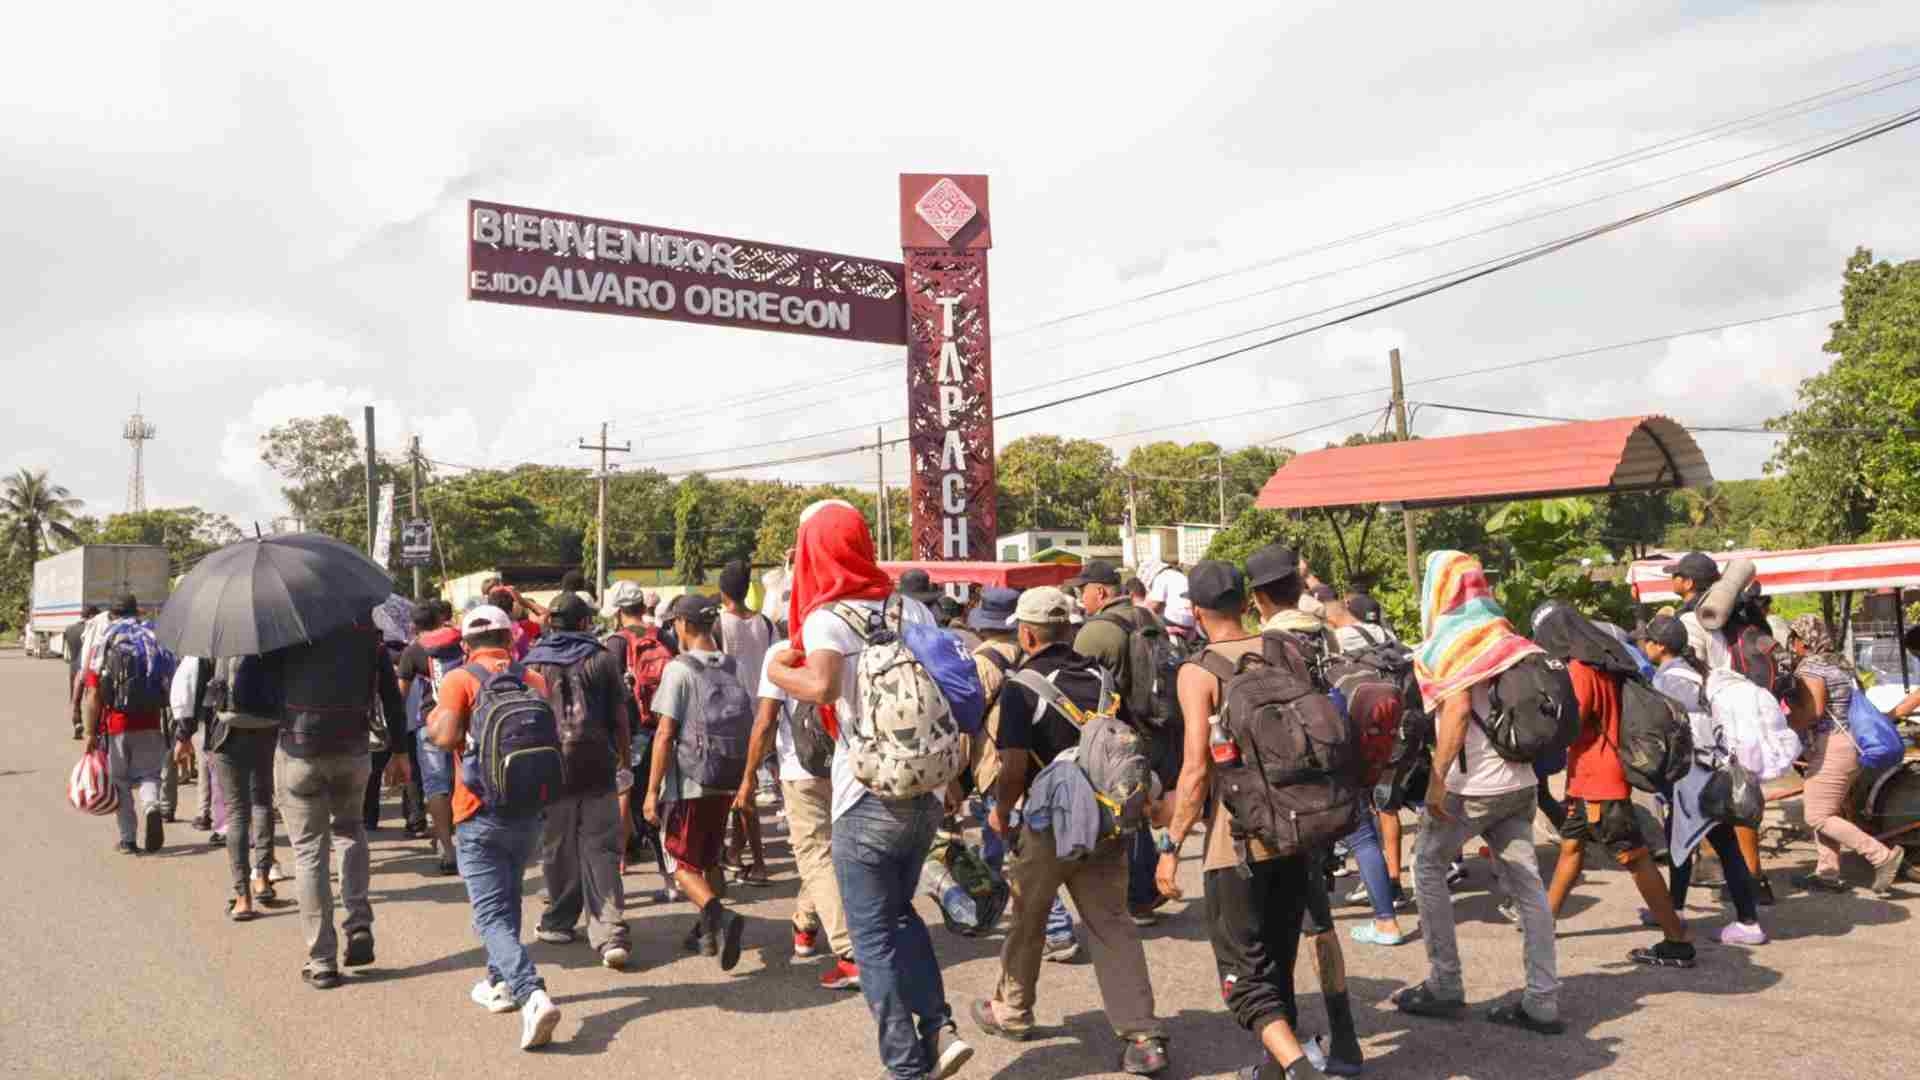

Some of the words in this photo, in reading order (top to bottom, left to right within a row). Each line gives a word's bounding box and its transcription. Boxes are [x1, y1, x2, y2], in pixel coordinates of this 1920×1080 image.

[473, 208, 737, 275] BIENVENIDOS
[471, 270, 538, 295] EJIDO
[537, 265, 676, 311] ALVARO
[684, 284, 850, 331] OBREGON
